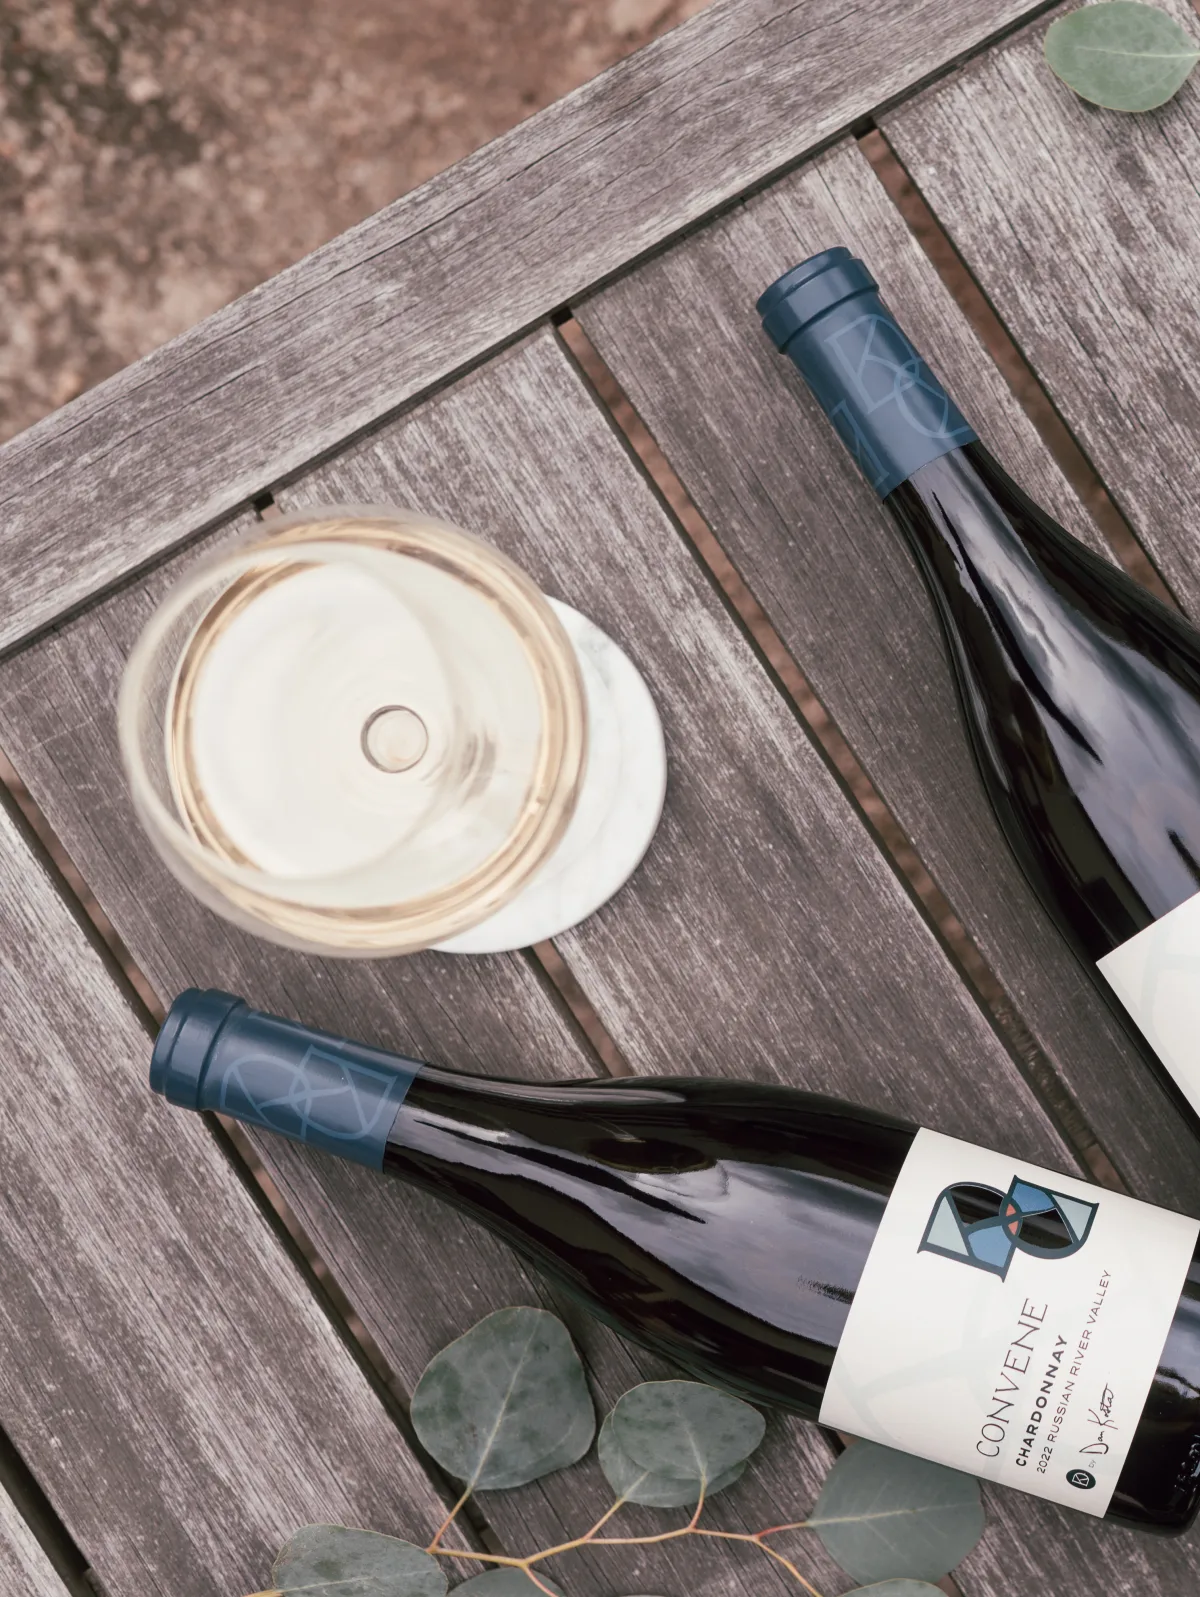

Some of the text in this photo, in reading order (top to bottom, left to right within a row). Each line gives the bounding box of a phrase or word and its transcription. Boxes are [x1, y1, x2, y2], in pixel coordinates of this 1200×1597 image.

[976, 1298, 1048, 1458] CONVENE
[1015, 1335, 1067, 1467] CHARDONNAY
[1036, 1270, 1111, 1474] 2022 RUSSIAN RIVER VALLEY
